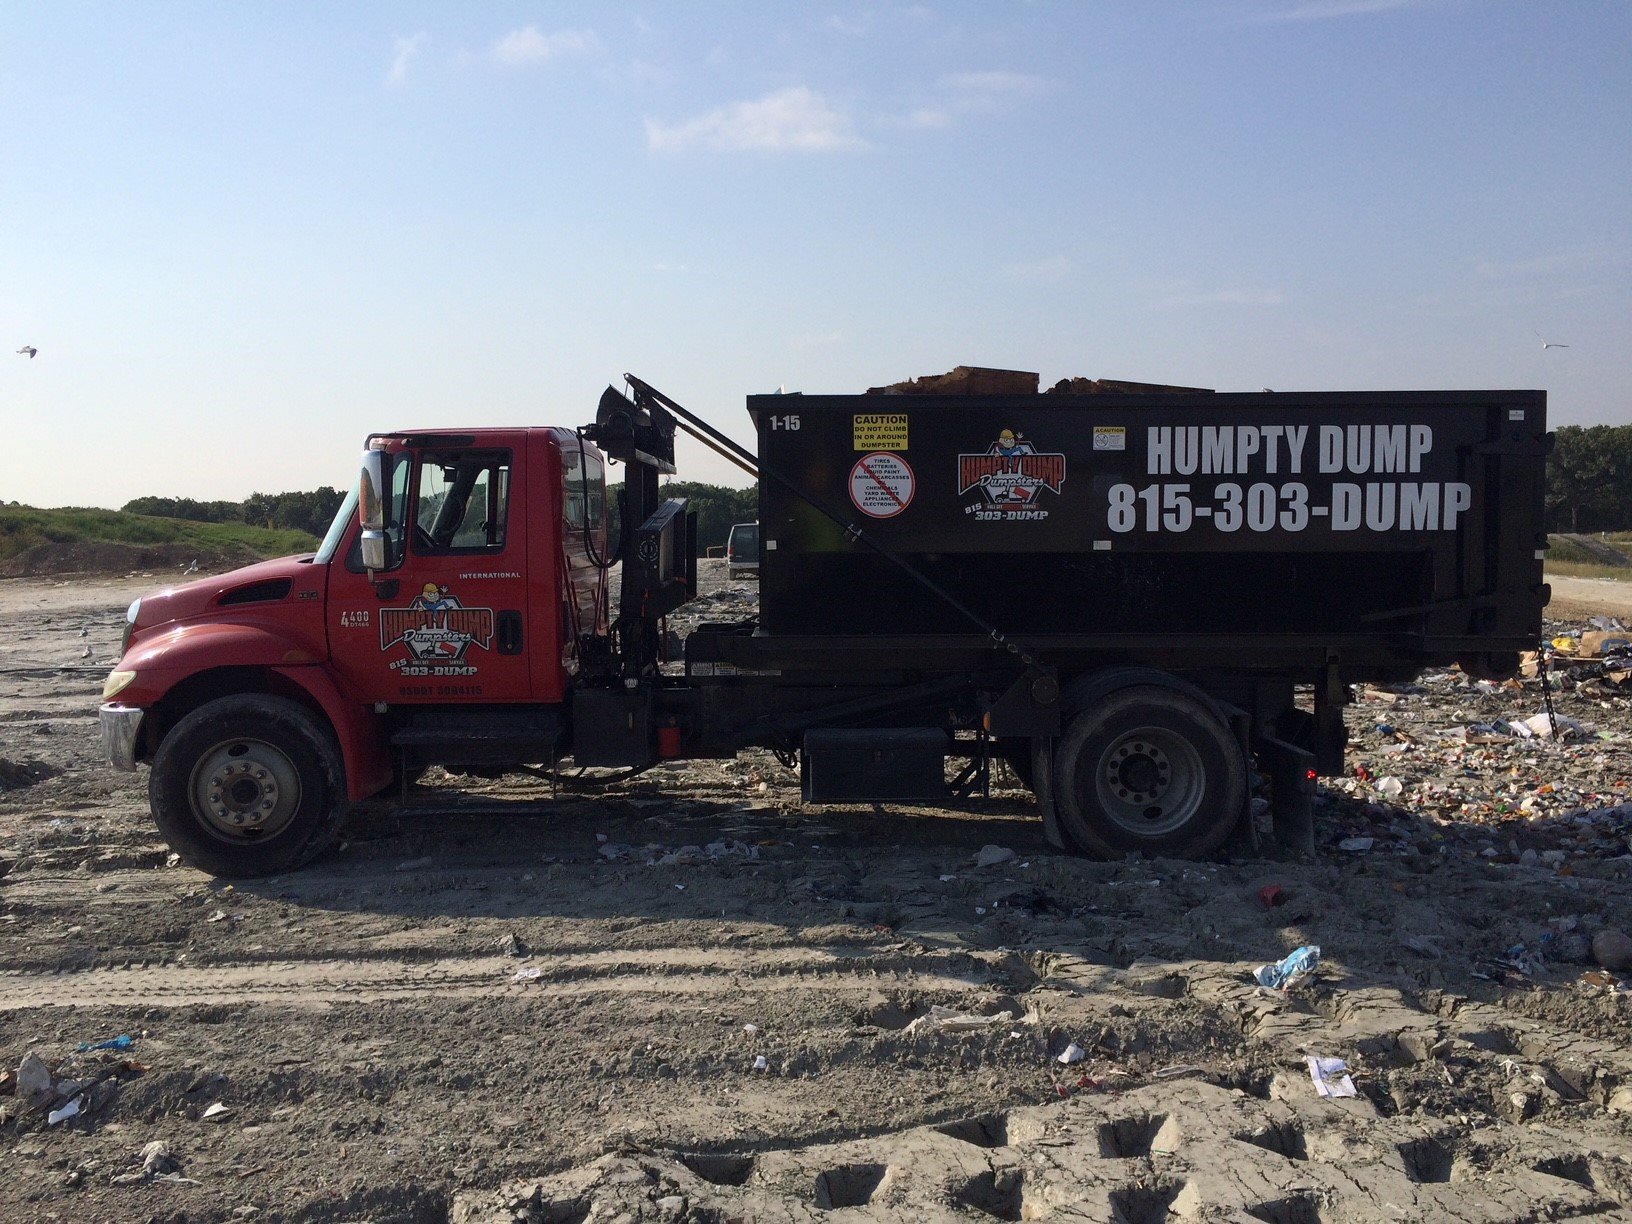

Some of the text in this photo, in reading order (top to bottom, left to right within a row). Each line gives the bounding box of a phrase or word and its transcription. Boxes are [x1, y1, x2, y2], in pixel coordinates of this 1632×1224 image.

[770, 415, 800, 431] 1-15
[855, 416, 907, 424] CAUTION
[1147, 424, 1433, 475] HUMPTY DUMP
[960, 455, 1064, 491] HUMPTY DUMP
[979, 475, 1044, 490] Dumpsters
[964, 503, 982, 515] 815
[975, 510, 1049, 521] 303-DUMP
[1107, 482, 1472, 533] 815-303-DUMP
[341, 611, 369, 627] 4400
[383, 610, 492, 646] HUMPTY DUMP
[403, 629, 473, 645] Dumpsters
[389, 658, 407, 670] 815
[401, 666, 478, 676] 303-DUMP
